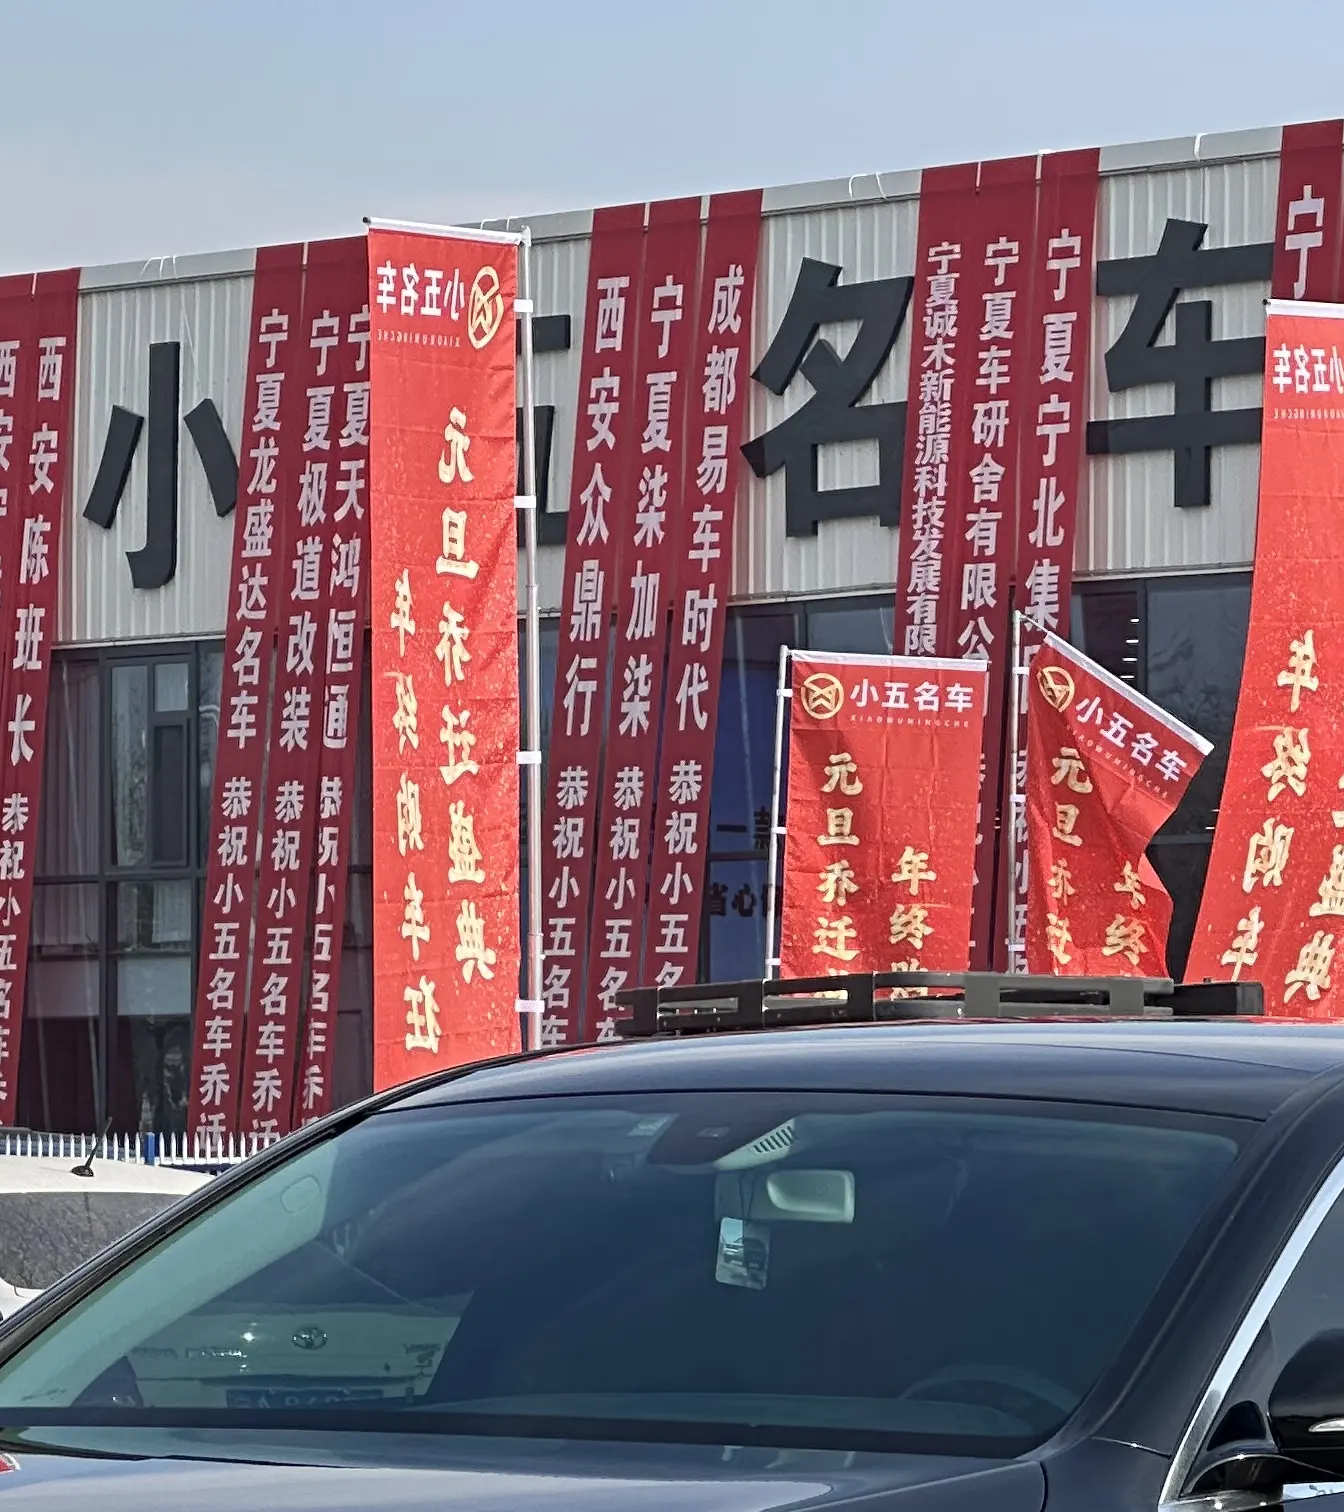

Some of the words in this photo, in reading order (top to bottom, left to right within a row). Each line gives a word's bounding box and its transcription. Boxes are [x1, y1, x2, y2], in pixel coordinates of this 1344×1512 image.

[8, 336, 66, 766] 西安陈班长
[227, 309, 288, 748] 宁夏龙盛达名车
[279, 310, 339, 752] 宁夏极道改装
[563, 275, 629, 737] 西安众鼎行
[618, 275, 684, 737] 宁夏柒加柒
[676, 264, 744, 731] 成都易车时代
[957, 236, 1019, 690] 宁夏车研舍有限公
[849, 678, 974, 713] 小五名车
[1075, 694, 1188, 784] 小五名车
[301, 776, 342, 1130] 恭祝小五名车乔
